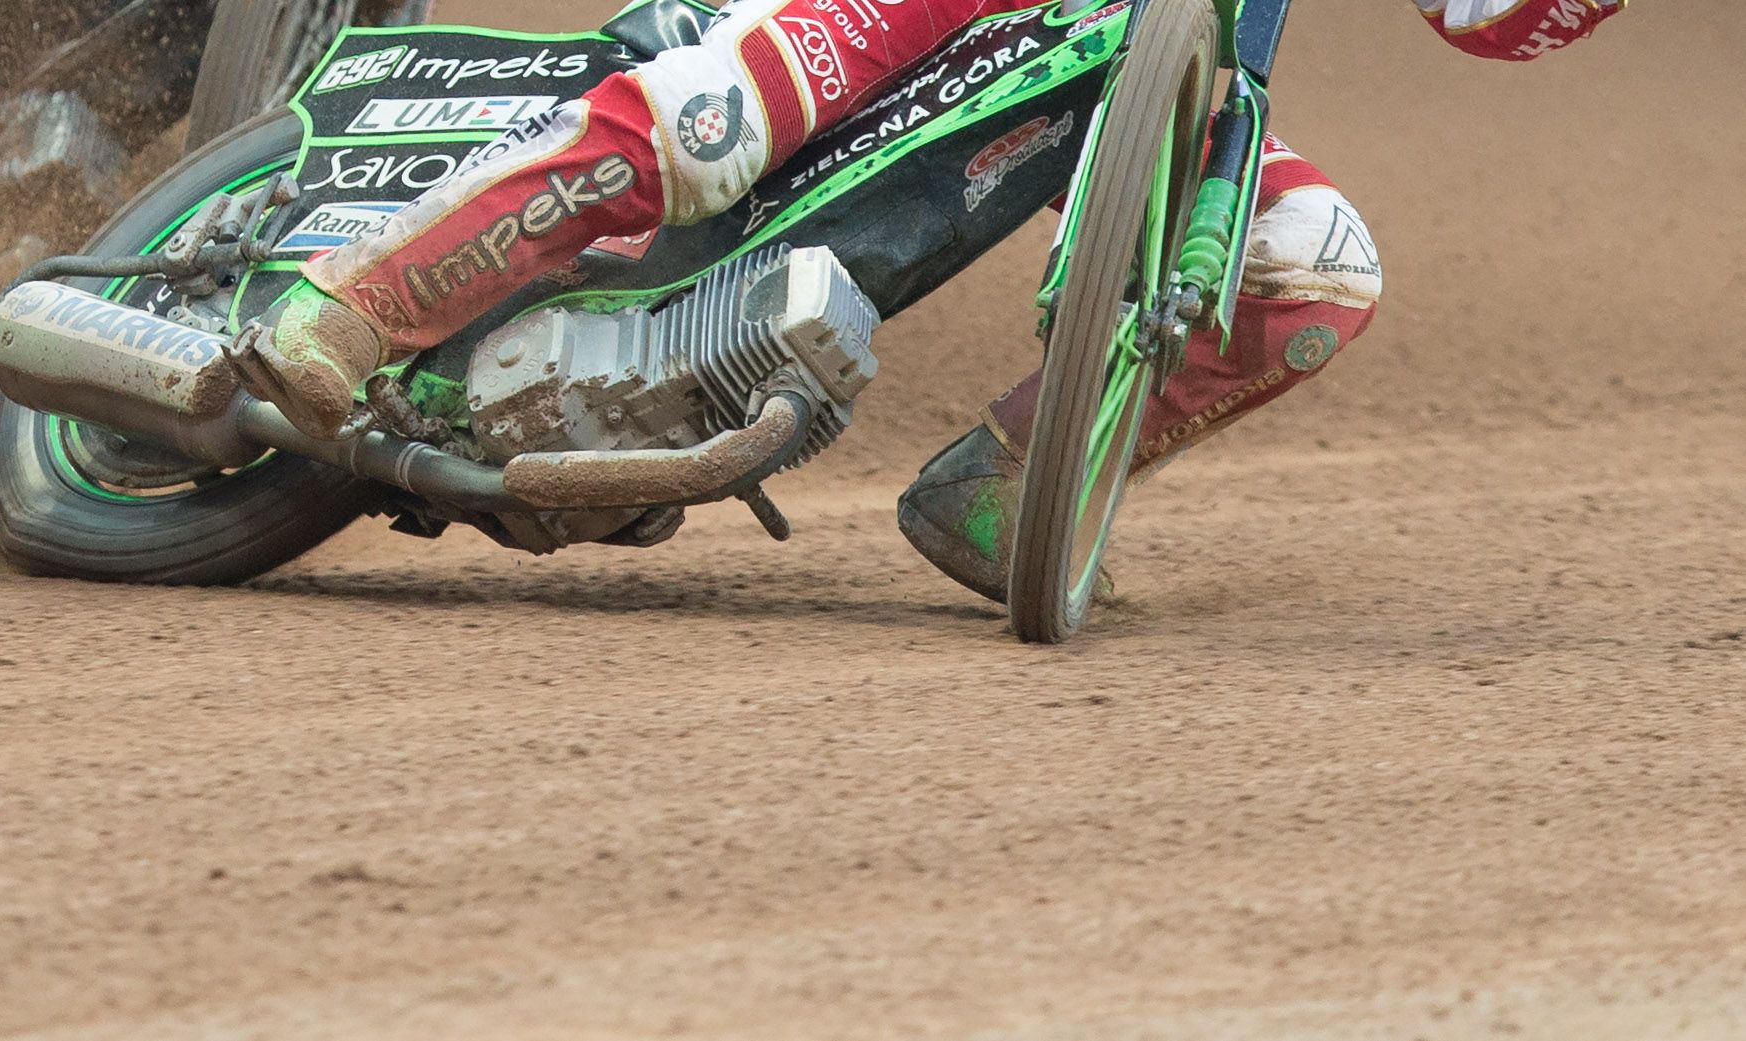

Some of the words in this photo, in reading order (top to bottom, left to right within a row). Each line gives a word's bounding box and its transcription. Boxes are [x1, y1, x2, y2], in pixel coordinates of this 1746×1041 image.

[315, 46, 402, 94] 692
[391, 48, 590, 90] Impeks
[938, 35, 1042, 105] GÓRA
[404, 153, 639, 310] Impeks
[44, 295, 225, 368] MARWIS
